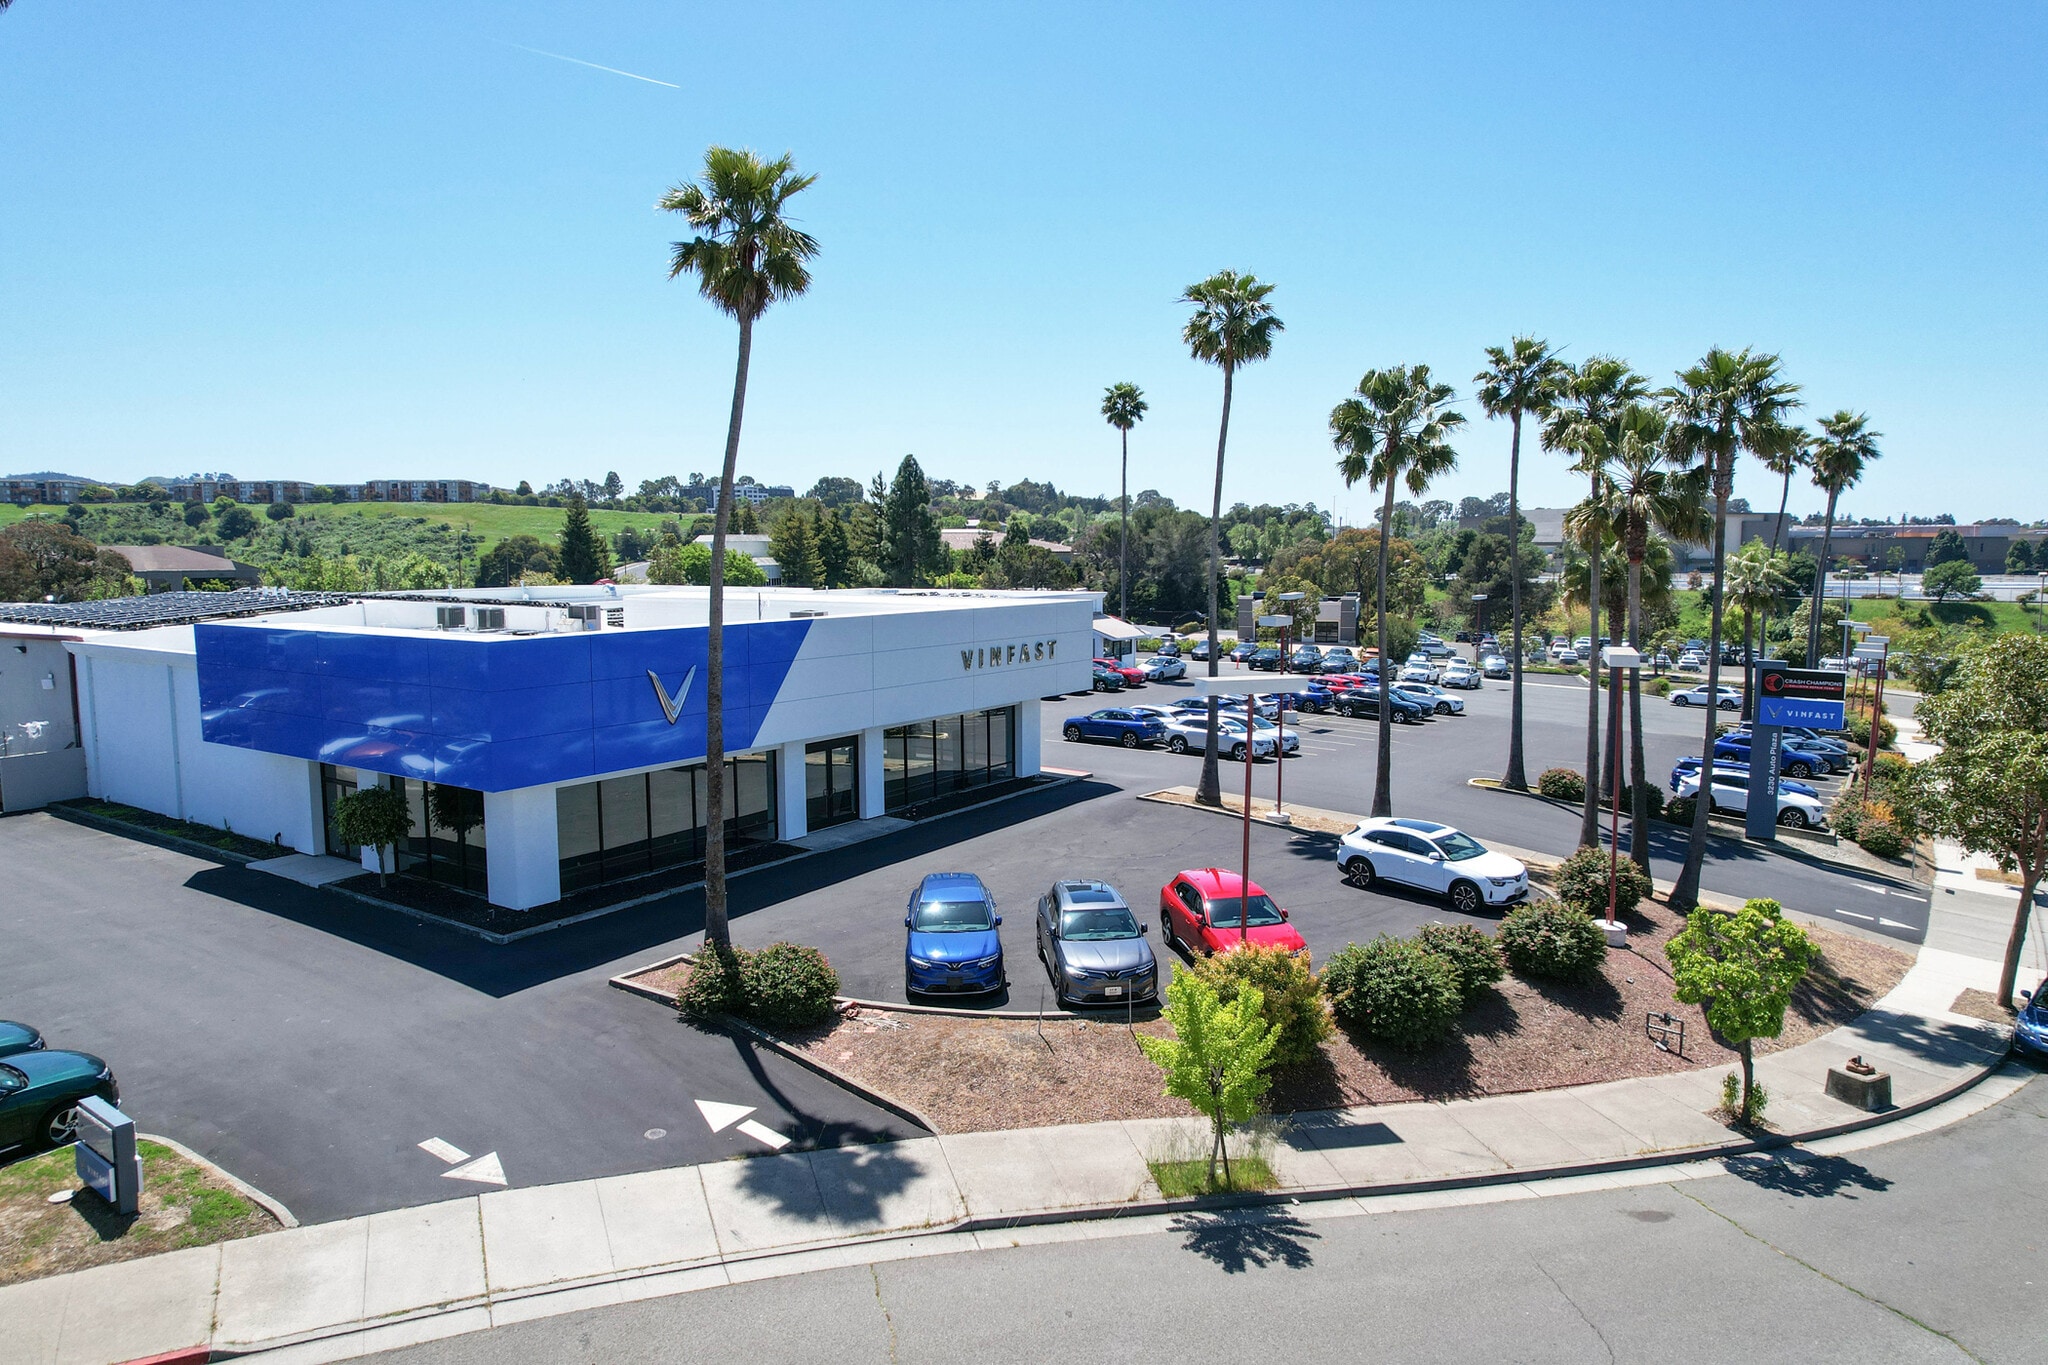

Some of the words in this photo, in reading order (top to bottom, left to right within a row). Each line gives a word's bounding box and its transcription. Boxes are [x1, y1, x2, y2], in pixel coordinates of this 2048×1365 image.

[961, 639, 1057, 672] VINFAST
[1806, 679, 1843, 687] CHAMPIONS
[1786, 710, 1836, 720] VINFAST
[1770, 732, 1778, 755] Plaza
[1769, 755, 1777, 775] Auto
[1767, 776, 1775, 796] 3230
